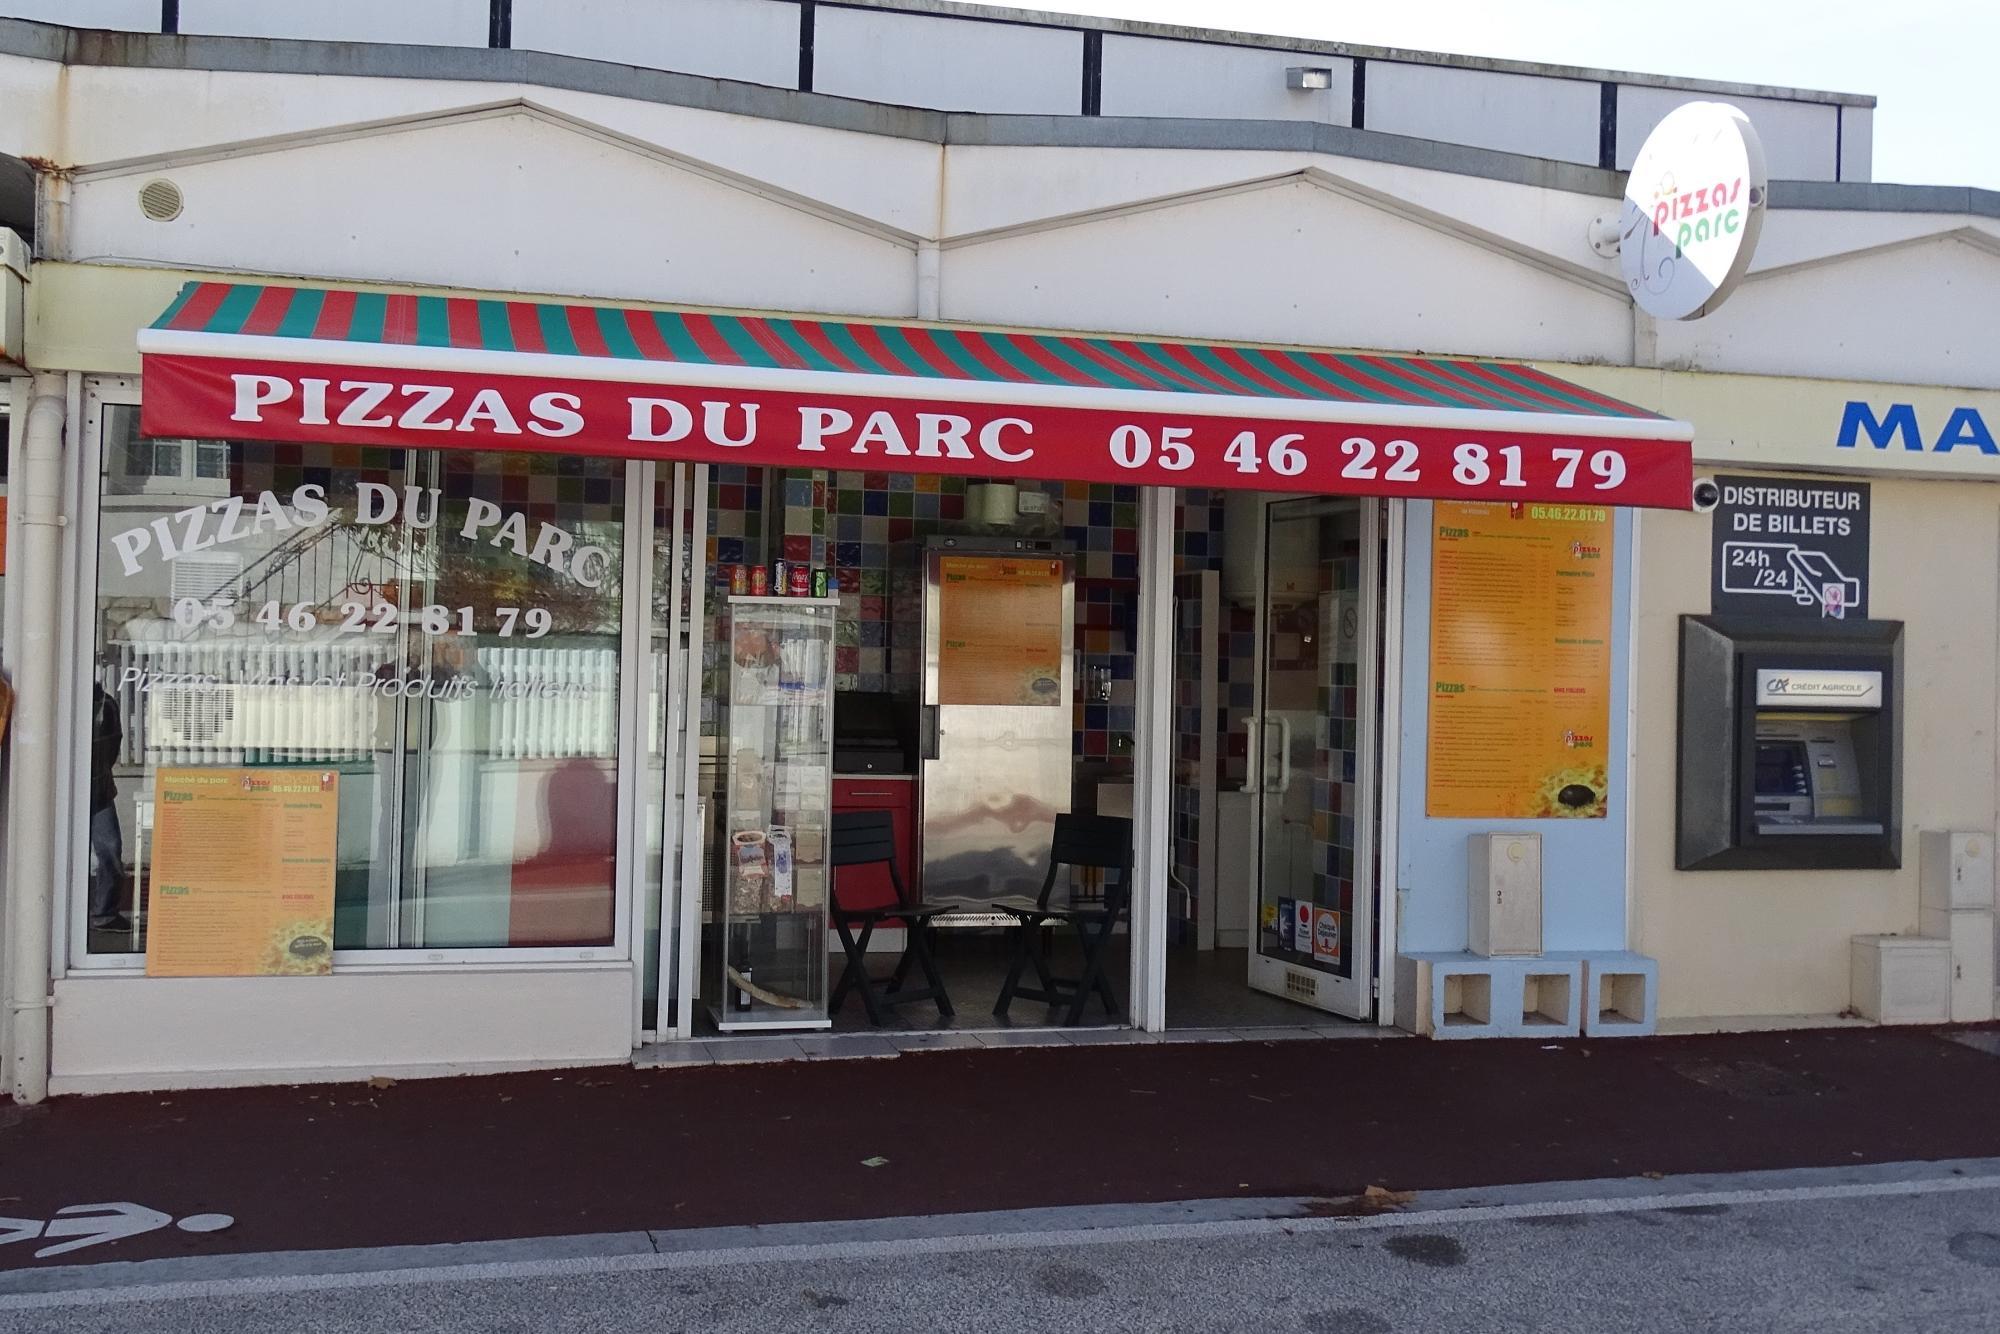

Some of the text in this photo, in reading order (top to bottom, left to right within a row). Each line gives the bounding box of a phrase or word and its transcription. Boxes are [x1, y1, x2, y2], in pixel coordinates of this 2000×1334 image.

[1653, 177, 1741, 236] pizzas
[1676, 208, 1739, 259] parc
[230, 373, 1627, 490] PIZZAS DU PARC 05 46 22 81 79
[1836, 401, 2000, 455] MA
[1724, 486, 1861, 511] DISTRIBUTEUR
[111, 482, 611, 588] PIZZAS DU PARC
[1439, 526, 1470, 538] Pizzas
[1733, 512, 1851, 536] DE BILLETS
[1732, 549, 1770, 567] 24h
[1754, 569, 1788, 587] /24
[172, 597, 552, 639] 05 46 22 81 79
[353, 670, 479, 699] Produits
[1435, 682, 1466, 693] Pizzas
[1791, 681, 1821, 692] CRÉDIT
[1822, 683, 1862, 693] AGRICOLE
